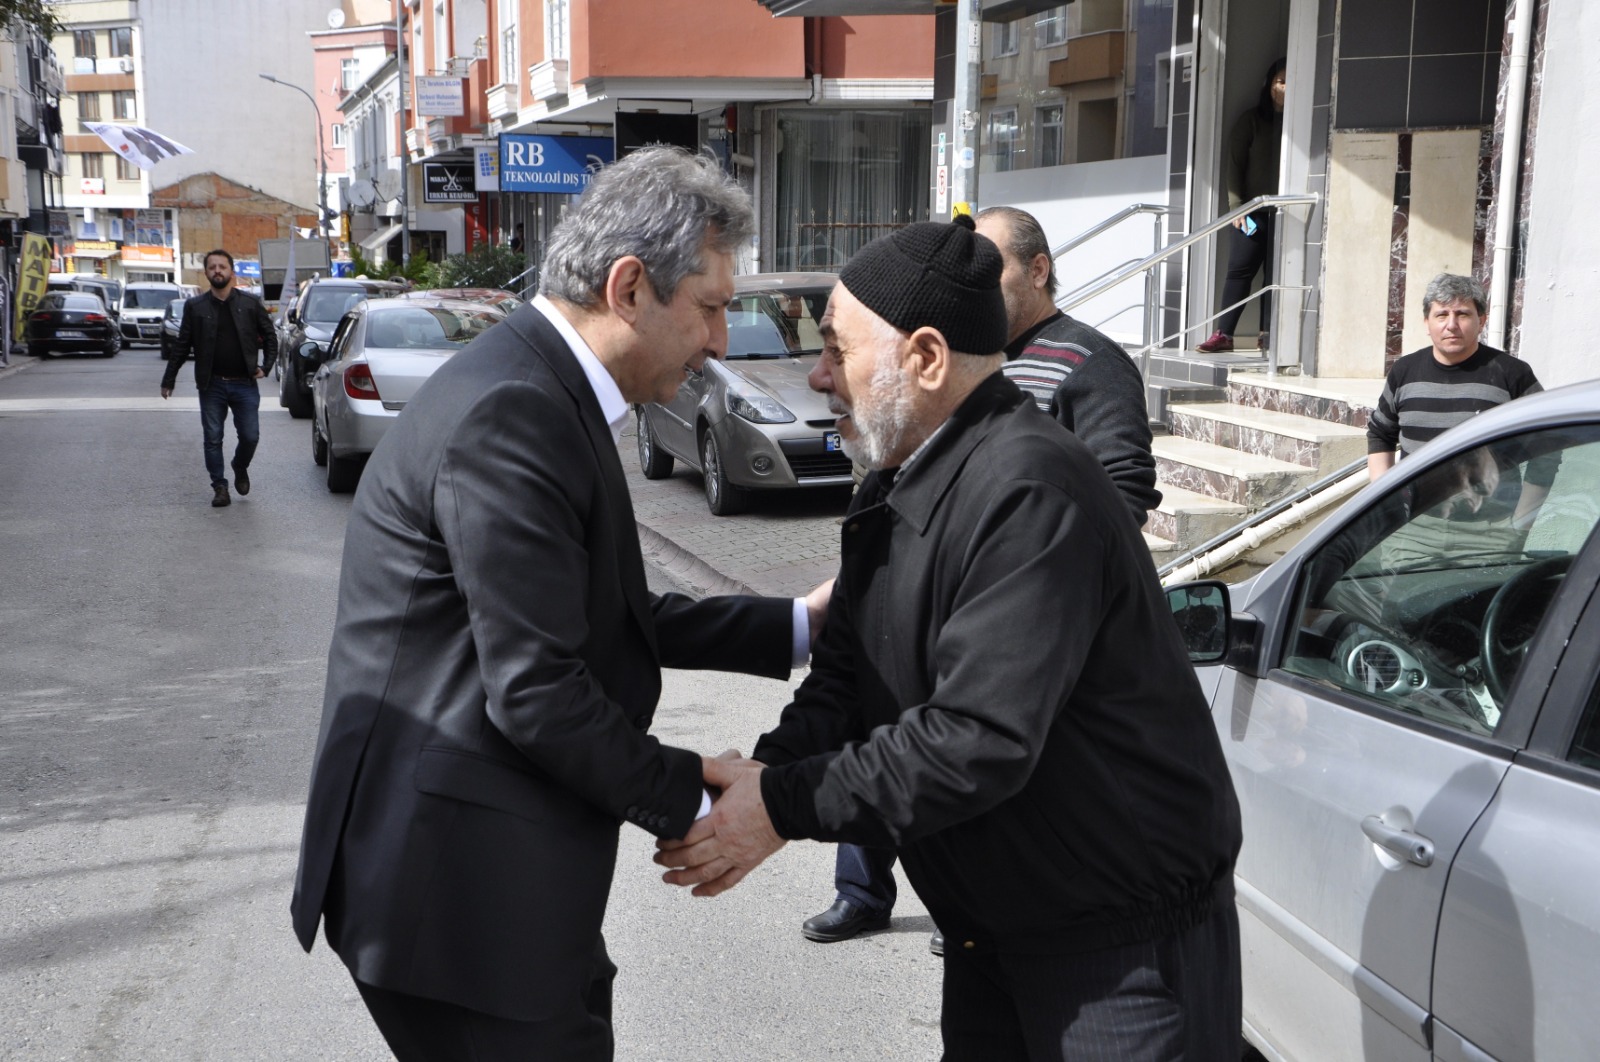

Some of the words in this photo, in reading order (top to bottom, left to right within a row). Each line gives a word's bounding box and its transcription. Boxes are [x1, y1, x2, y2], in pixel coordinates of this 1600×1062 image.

[506, 141, 545, 166] RB
[504, 170, 560, 184] TEKNOLOJİ
[563, 173, 578, 187] DIŞ
